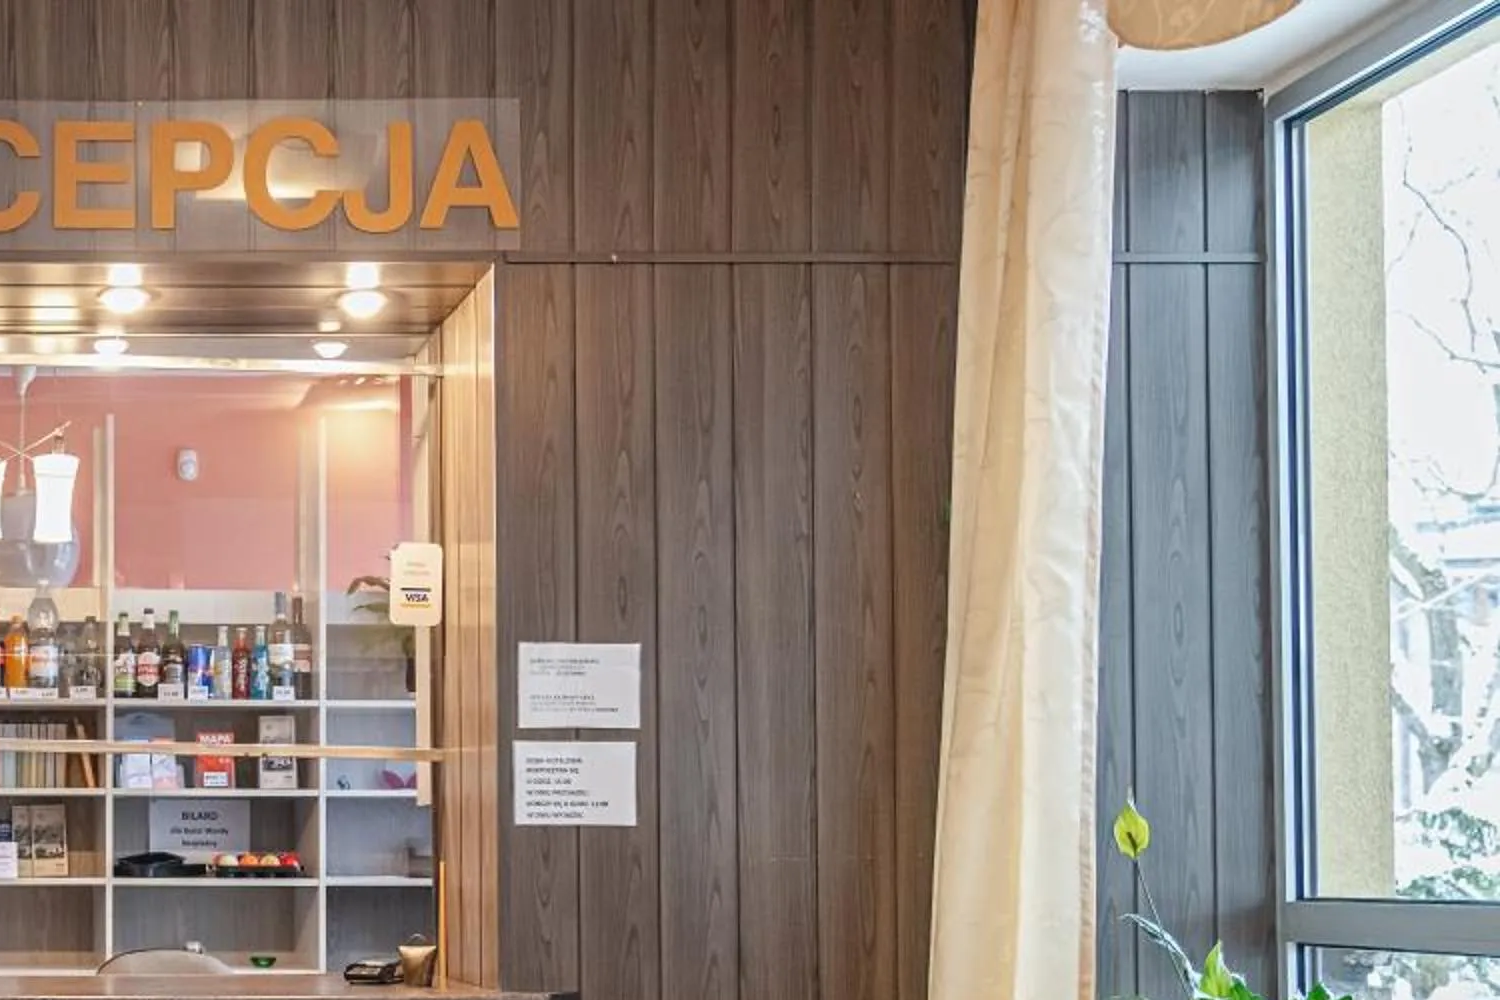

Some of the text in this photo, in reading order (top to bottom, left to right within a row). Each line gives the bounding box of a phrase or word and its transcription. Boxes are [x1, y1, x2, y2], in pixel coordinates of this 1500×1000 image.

[405, 593, 429, 602] VISA
[200, 734, 231, 744] MAPA
[181, 811, 219, 821] BILARD
